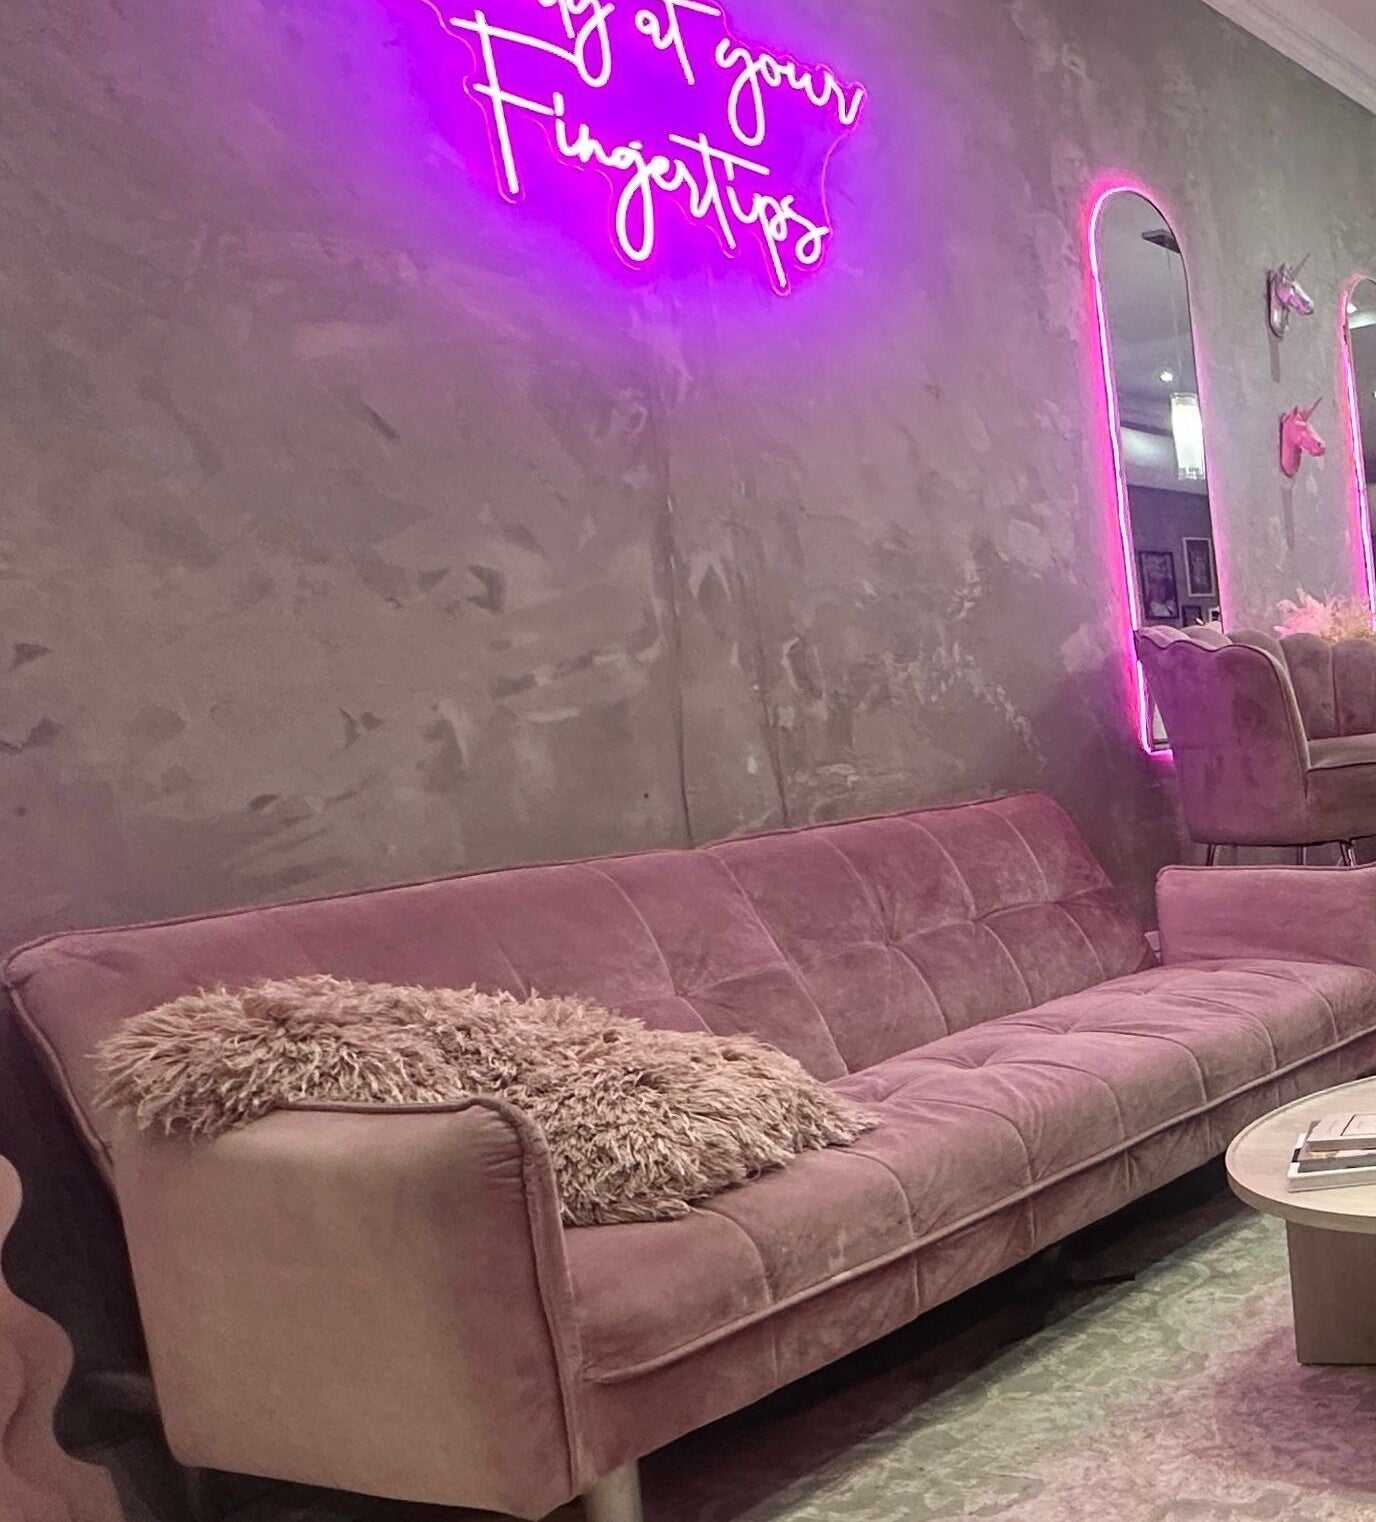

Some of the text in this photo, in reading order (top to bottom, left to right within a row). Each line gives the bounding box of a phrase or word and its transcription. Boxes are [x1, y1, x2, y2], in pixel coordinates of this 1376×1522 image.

[450, 10, 830, 288] Fingertips
[635, 0, 721, 86] at
[714, 37, 865, 147] your
